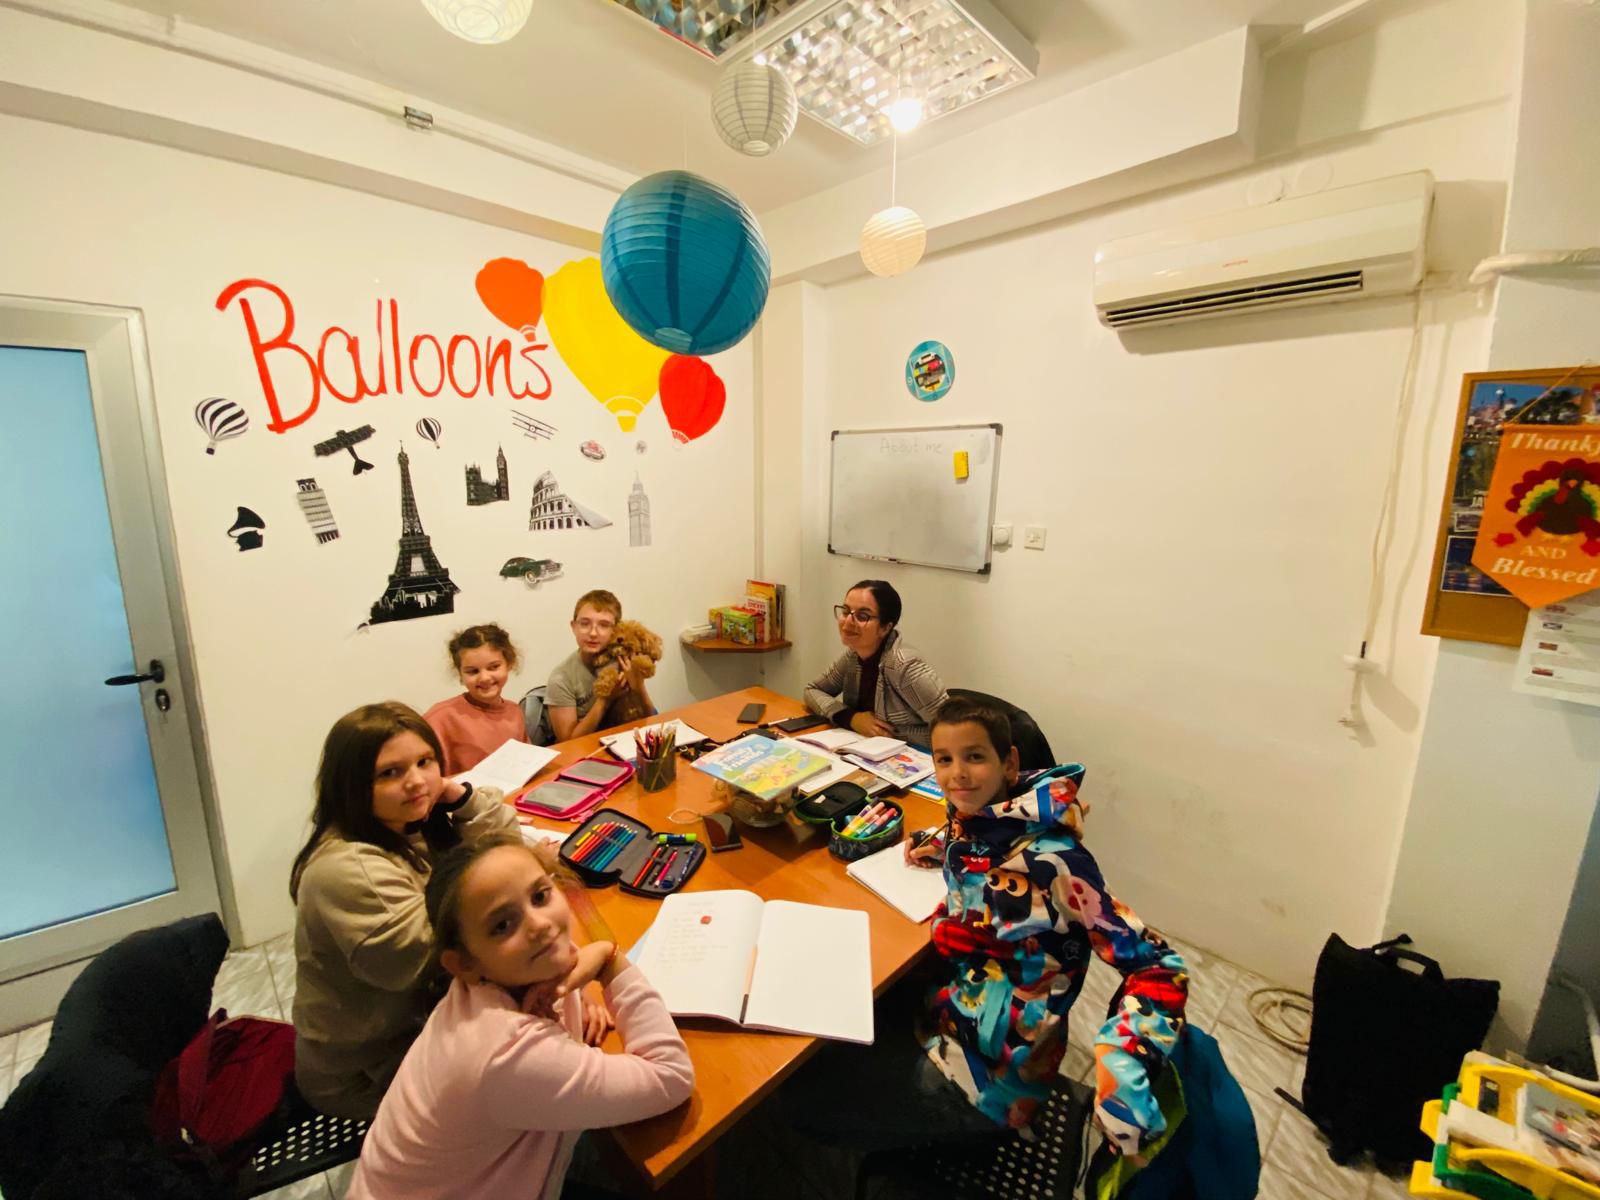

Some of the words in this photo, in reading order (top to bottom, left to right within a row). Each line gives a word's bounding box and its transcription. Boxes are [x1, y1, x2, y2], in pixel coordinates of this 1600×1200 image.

[215, 278, 552, 434] Balloons
[926, 441, 943, 454] me
[1520, 544, 1567, 560] AND
[1490, 557, 1599, 585] Blessed
